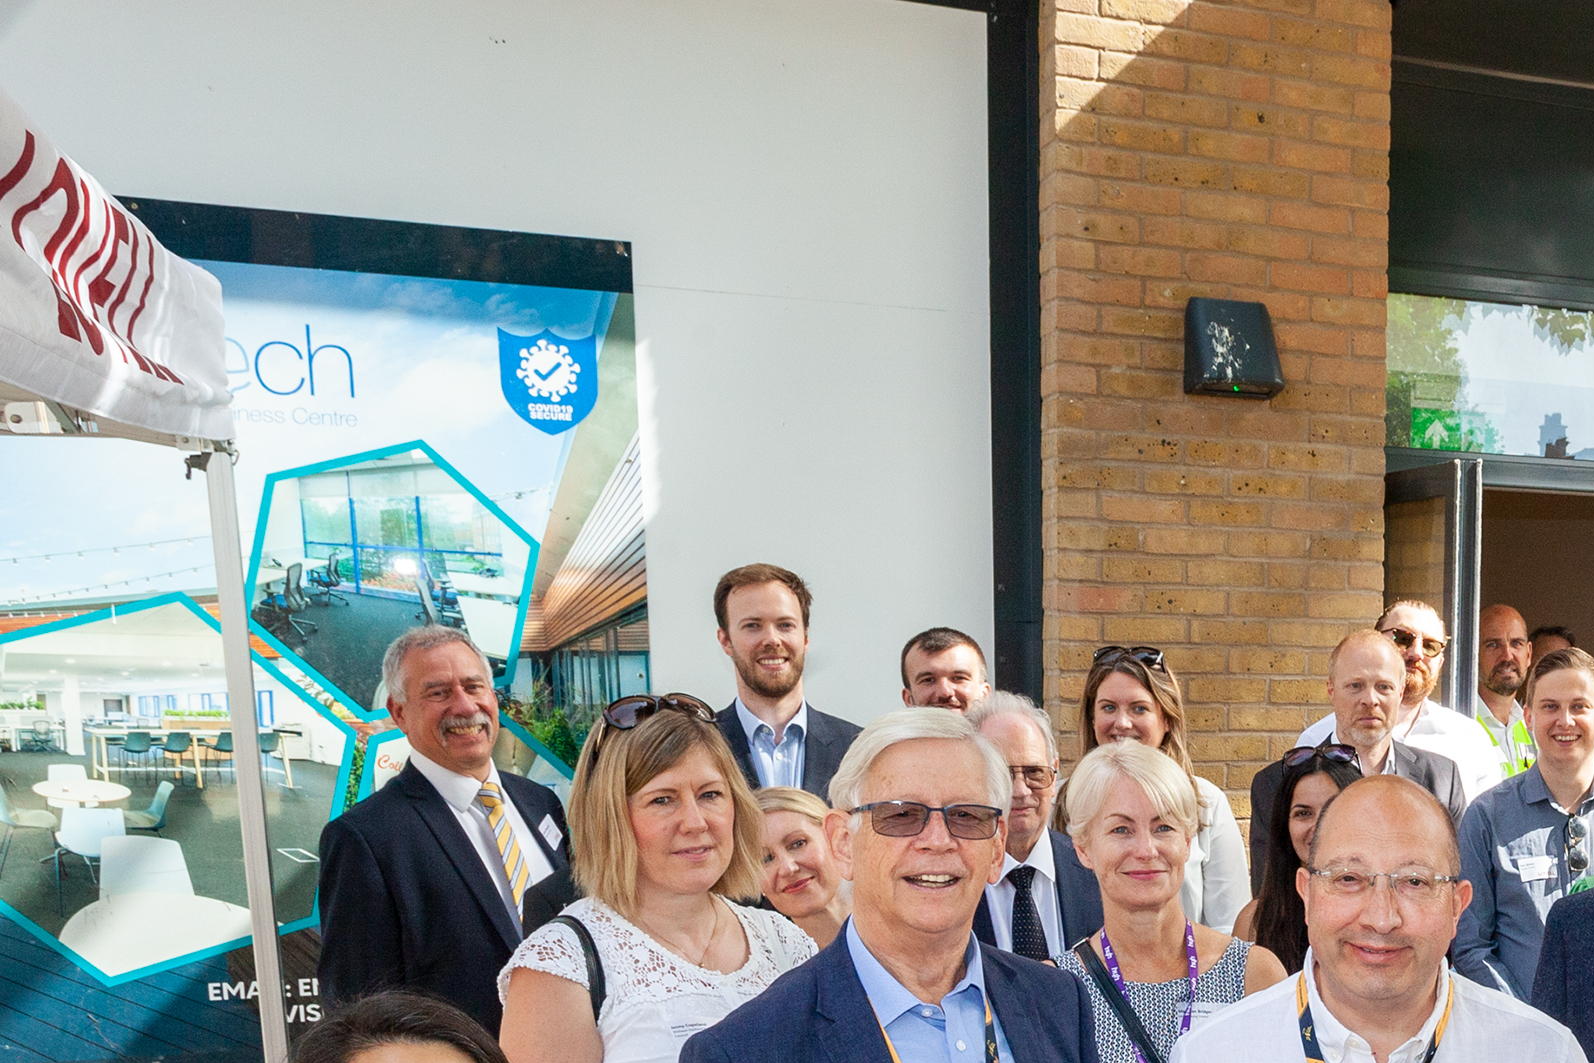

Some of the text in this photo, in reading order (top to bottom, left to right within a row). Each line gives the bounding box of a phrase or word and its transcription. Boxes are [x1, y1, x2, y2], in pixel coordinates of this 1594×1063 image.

[527, 402, 574, 414] COVID19
[292, 406, 358, 427] Centre
[529, 411, 573, 421] SECURE
